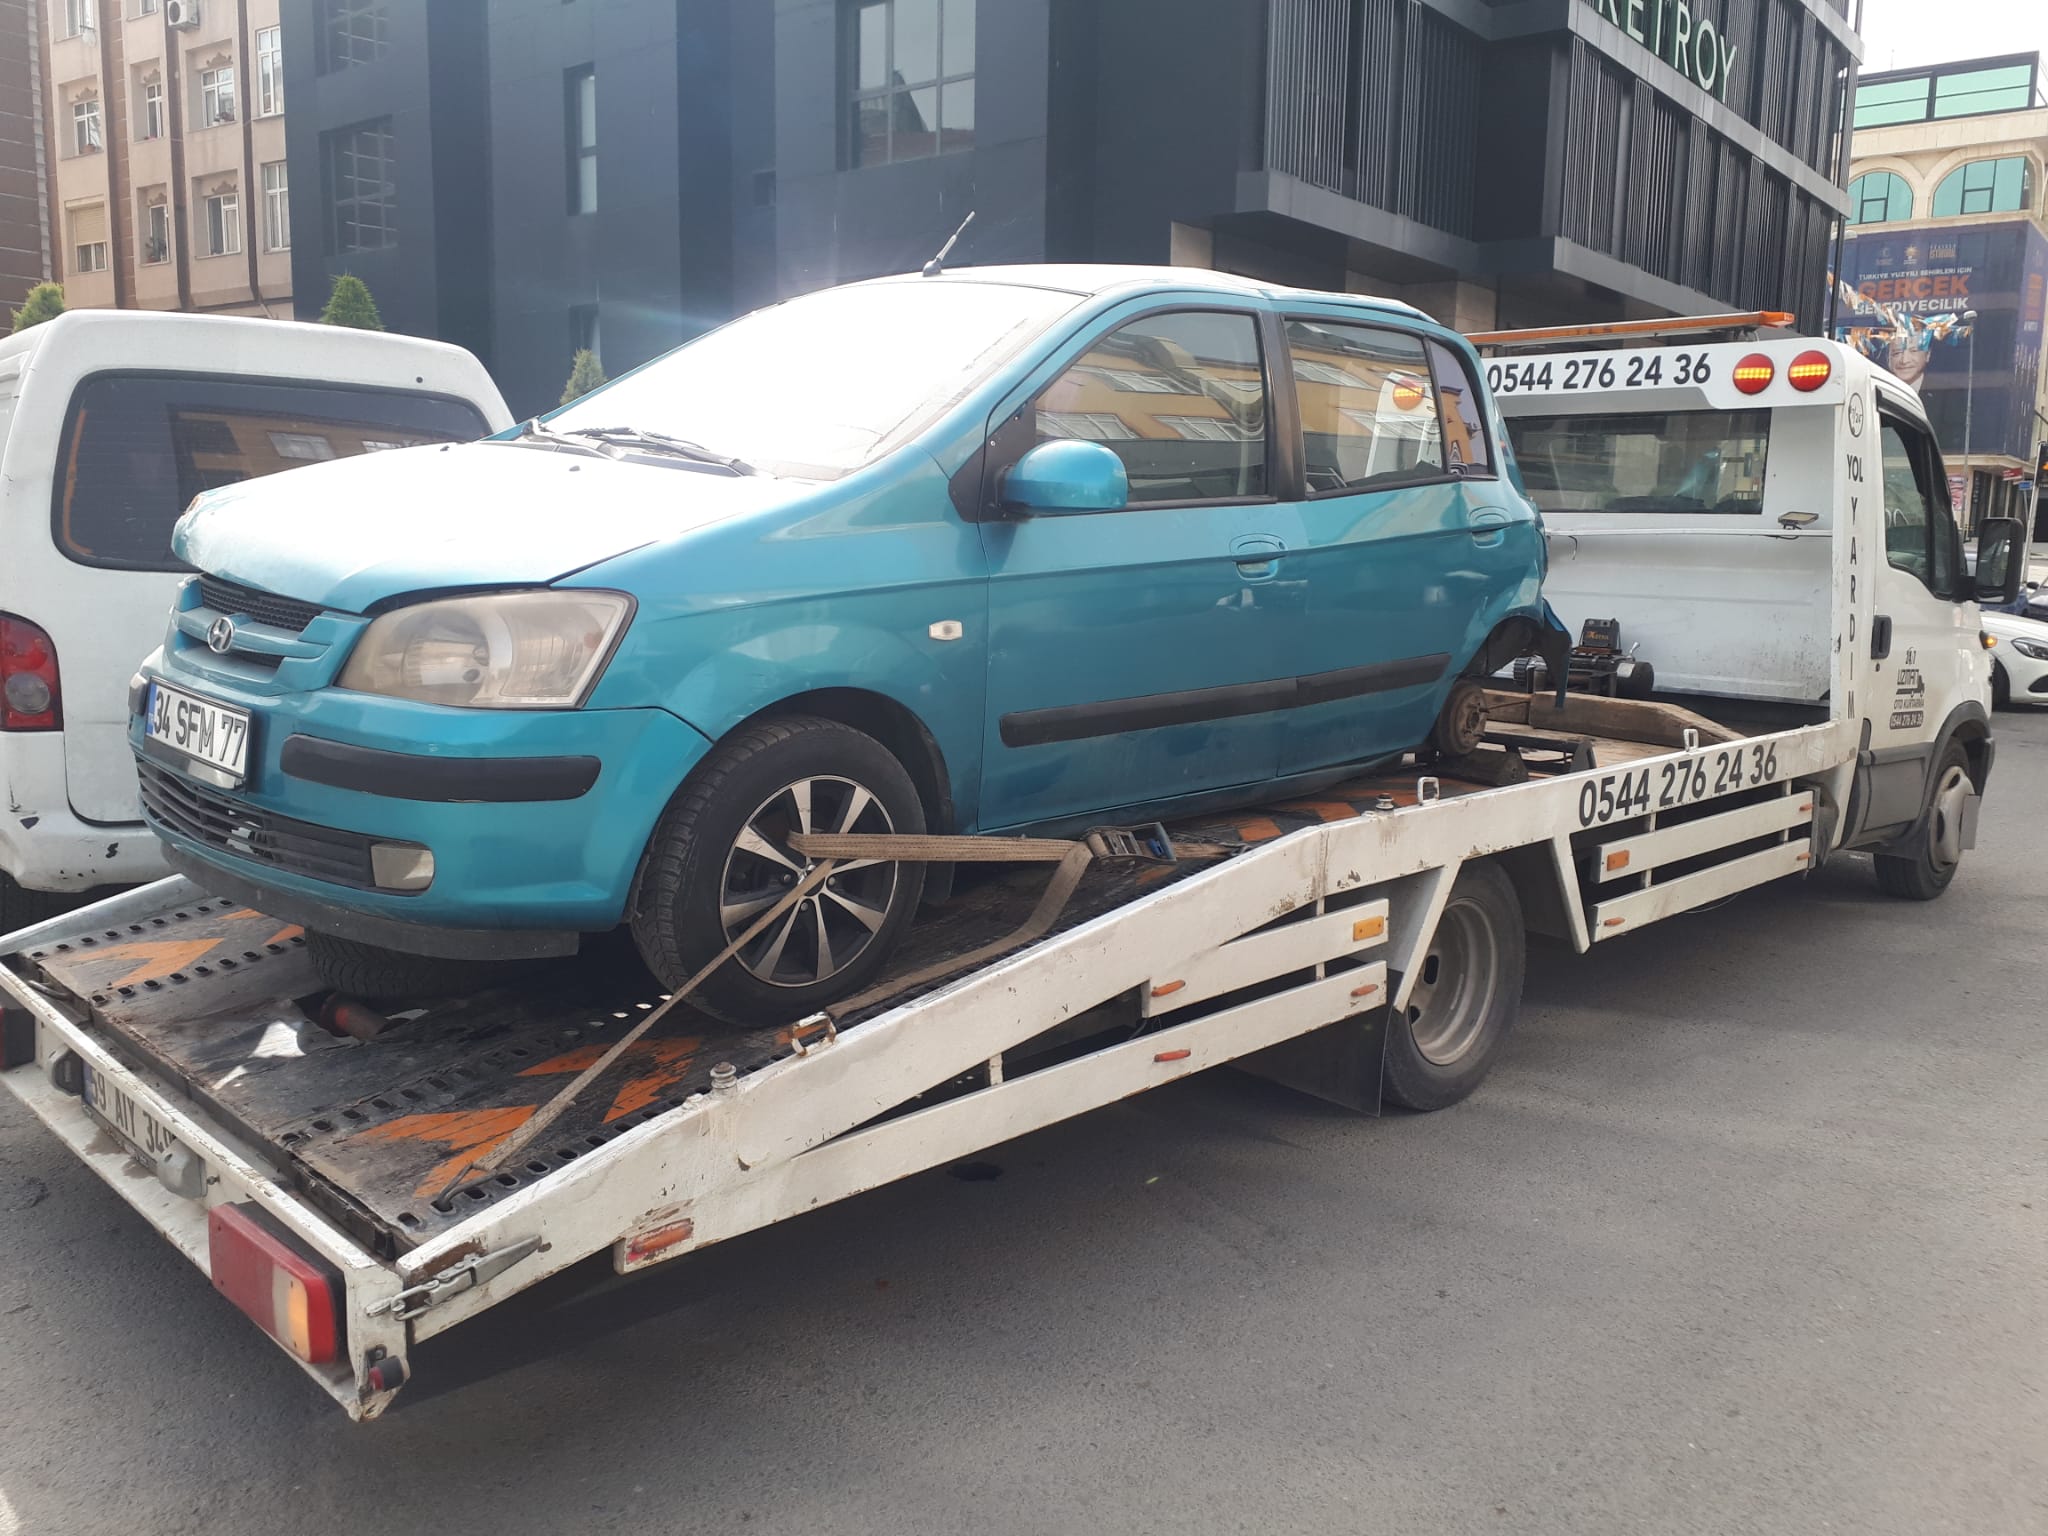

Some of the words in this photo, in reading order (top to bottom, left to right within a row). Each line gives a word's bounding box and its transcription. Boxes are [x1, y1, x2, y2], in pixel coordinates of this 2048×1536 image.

[1598, 0, 1737, 103] ETROY
[1488, 362, 1553, 393] 0544
[1563, 358, 1616, 389] 276
[1626, 355, 1662, 387] 24
[1673, 353, 1711, 385] 36
[1847, 454, 1863, 482] YOL
[1847, 497, 1858, 719] YARDIM
[153, 691, 171, 739] 34
[176, 700, 215, 758] SFM
[219, 713, 247, 767] 77
[1579, 767, 1650, 828] 0544
[1659, 756, 1707, 808] 276
[1714, 749, 1743, 794] 24
[1750, 742, 1777, 785] 36
